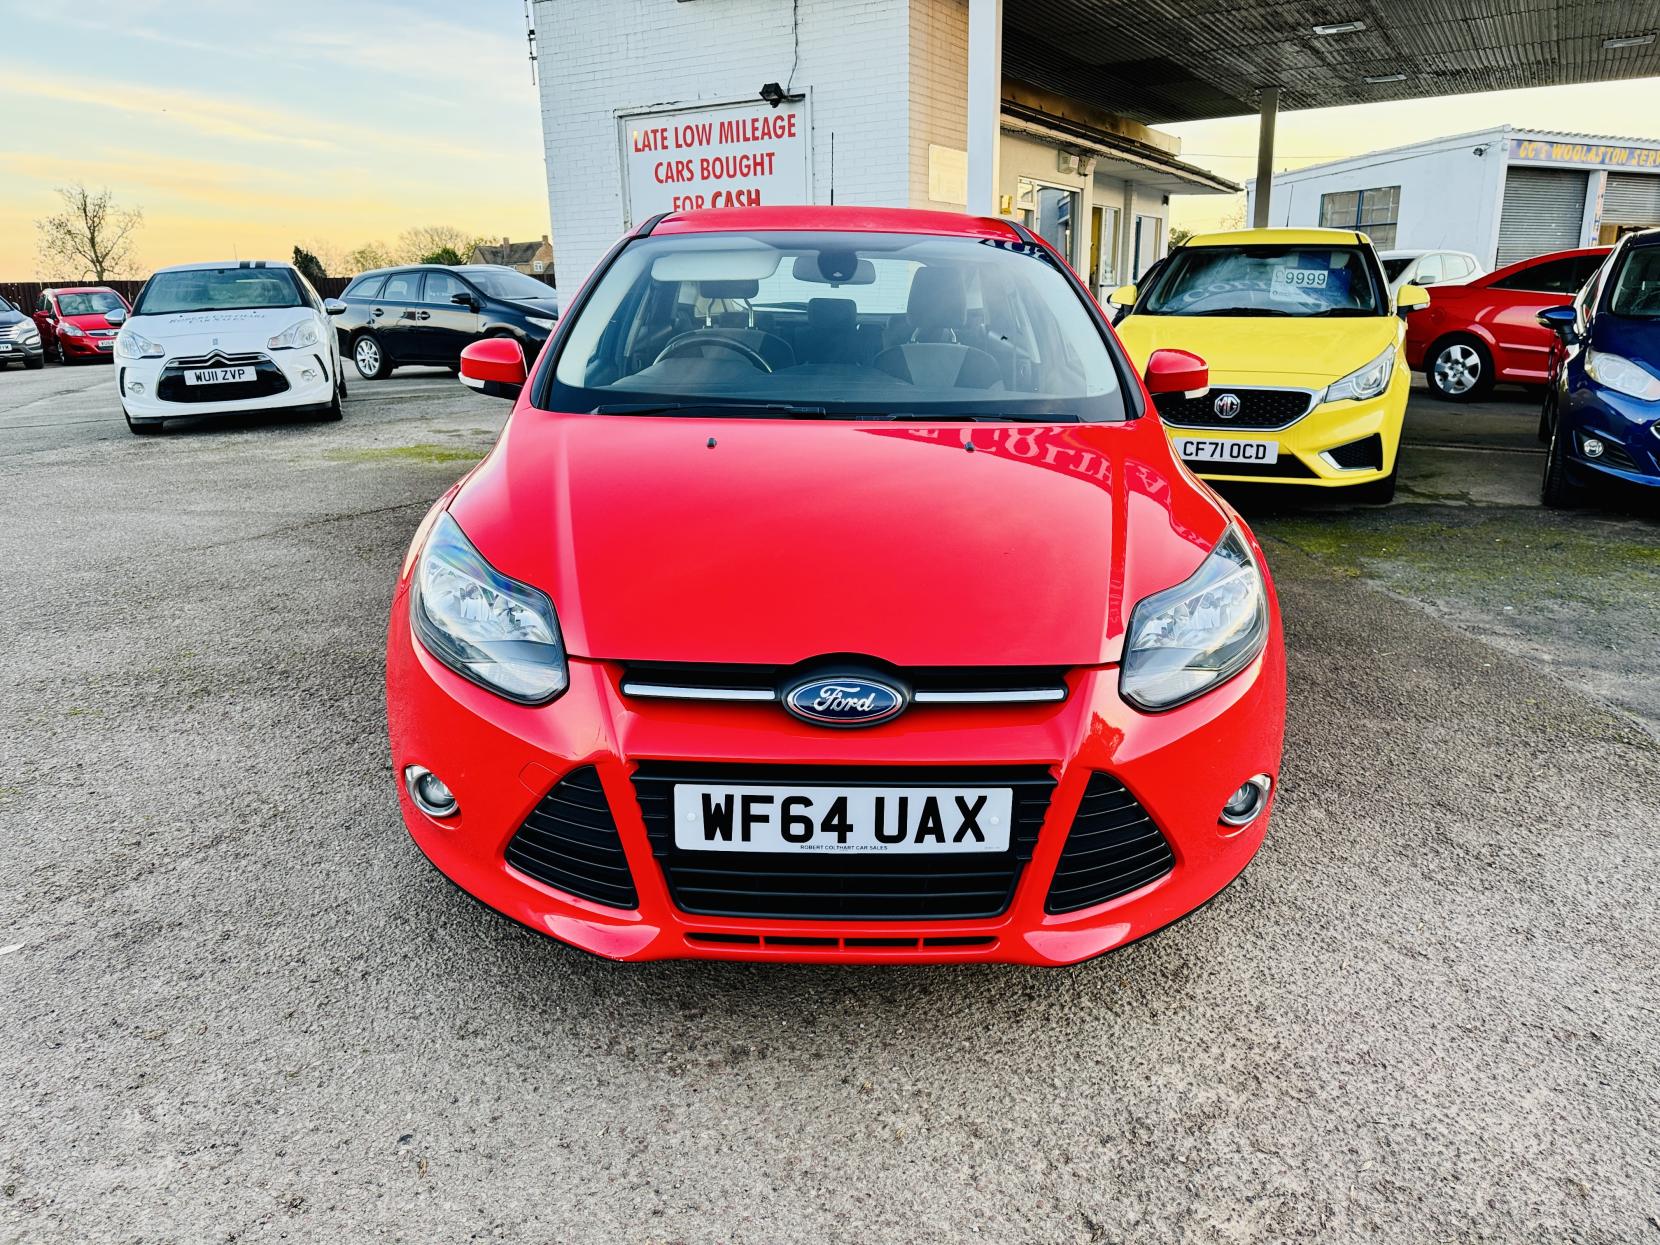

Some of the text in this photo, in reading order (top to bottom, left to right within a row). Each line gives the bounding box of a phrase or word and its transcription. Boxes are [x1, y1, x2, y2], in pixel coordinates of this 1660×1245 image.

[633, 113, 797, 153] LATE LOW MILEAGE
[654, 152, 776, 184] CARS BOUGHT
[672, 188, 761, 212] FOR CASH
[220, 368, 246, 381] ZVP
[1216, 396, 1239, 417] MG
[1183, 440, 1267, 460] CF71 OCD
[813, 685, 875, 712] Ford
[701, 792, 988, 844] WF64 UAX
